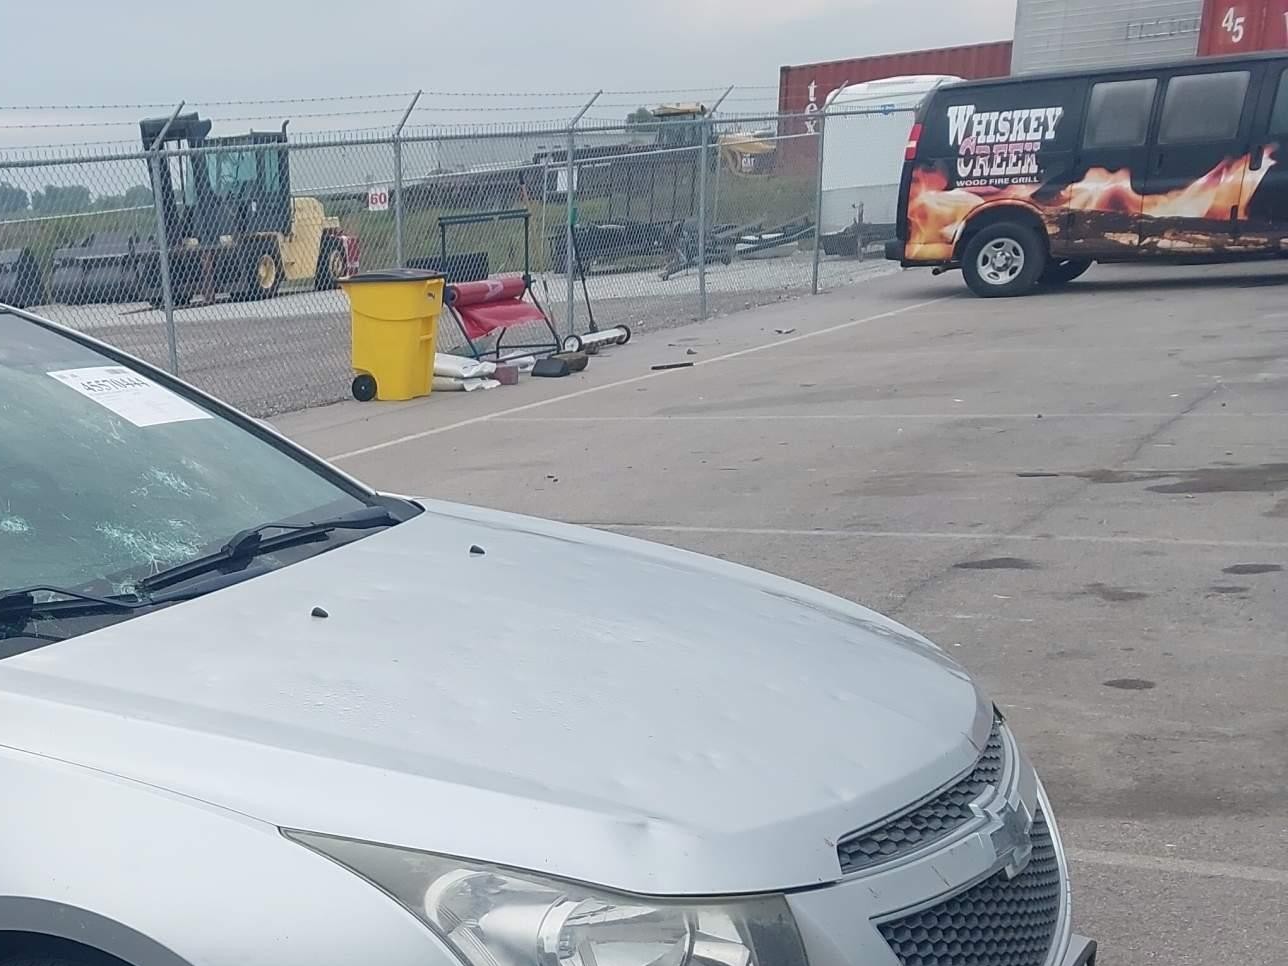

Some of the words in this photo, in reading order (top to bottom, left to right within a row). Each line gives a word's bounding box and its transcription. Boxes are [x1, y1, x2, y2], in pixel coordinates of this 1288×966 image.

[955, 179, 987, 187] WOOD
[989, 177, 1010, 185] FIRE
[1011, 175, 1040, 184] GRILL
